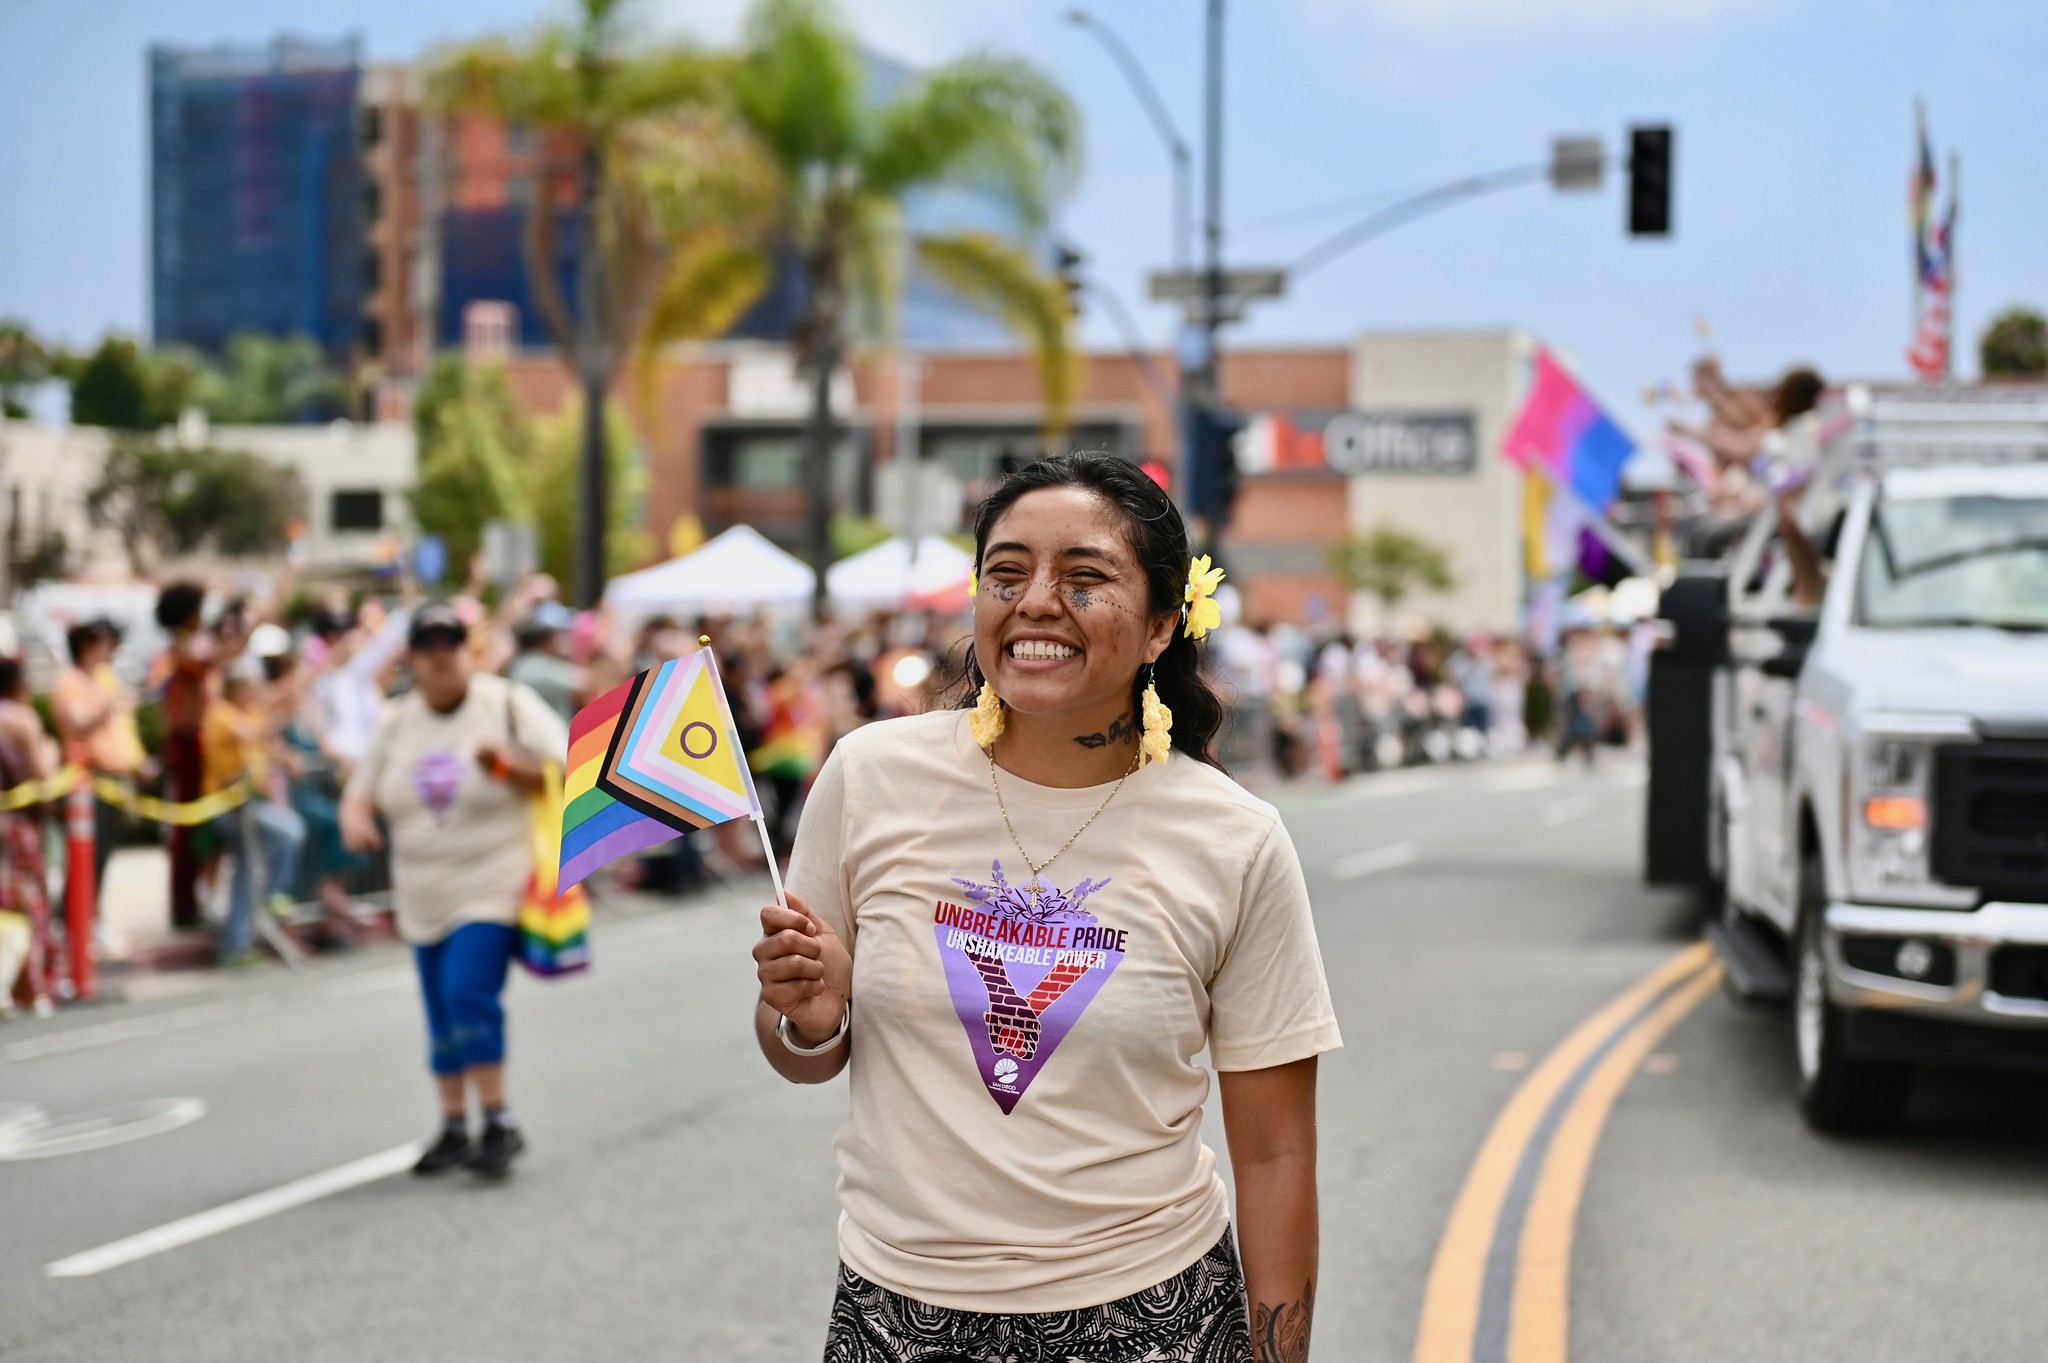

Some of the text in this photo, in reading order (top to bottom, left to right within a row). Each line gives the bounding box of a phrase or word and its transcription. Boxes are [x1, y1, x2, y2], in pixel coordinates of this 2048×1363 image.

[934, 900, 1129, 953] UNBREAKABLE PRIDE
[946, 929, 1107, 969] UNSHAKEABLE POWER
